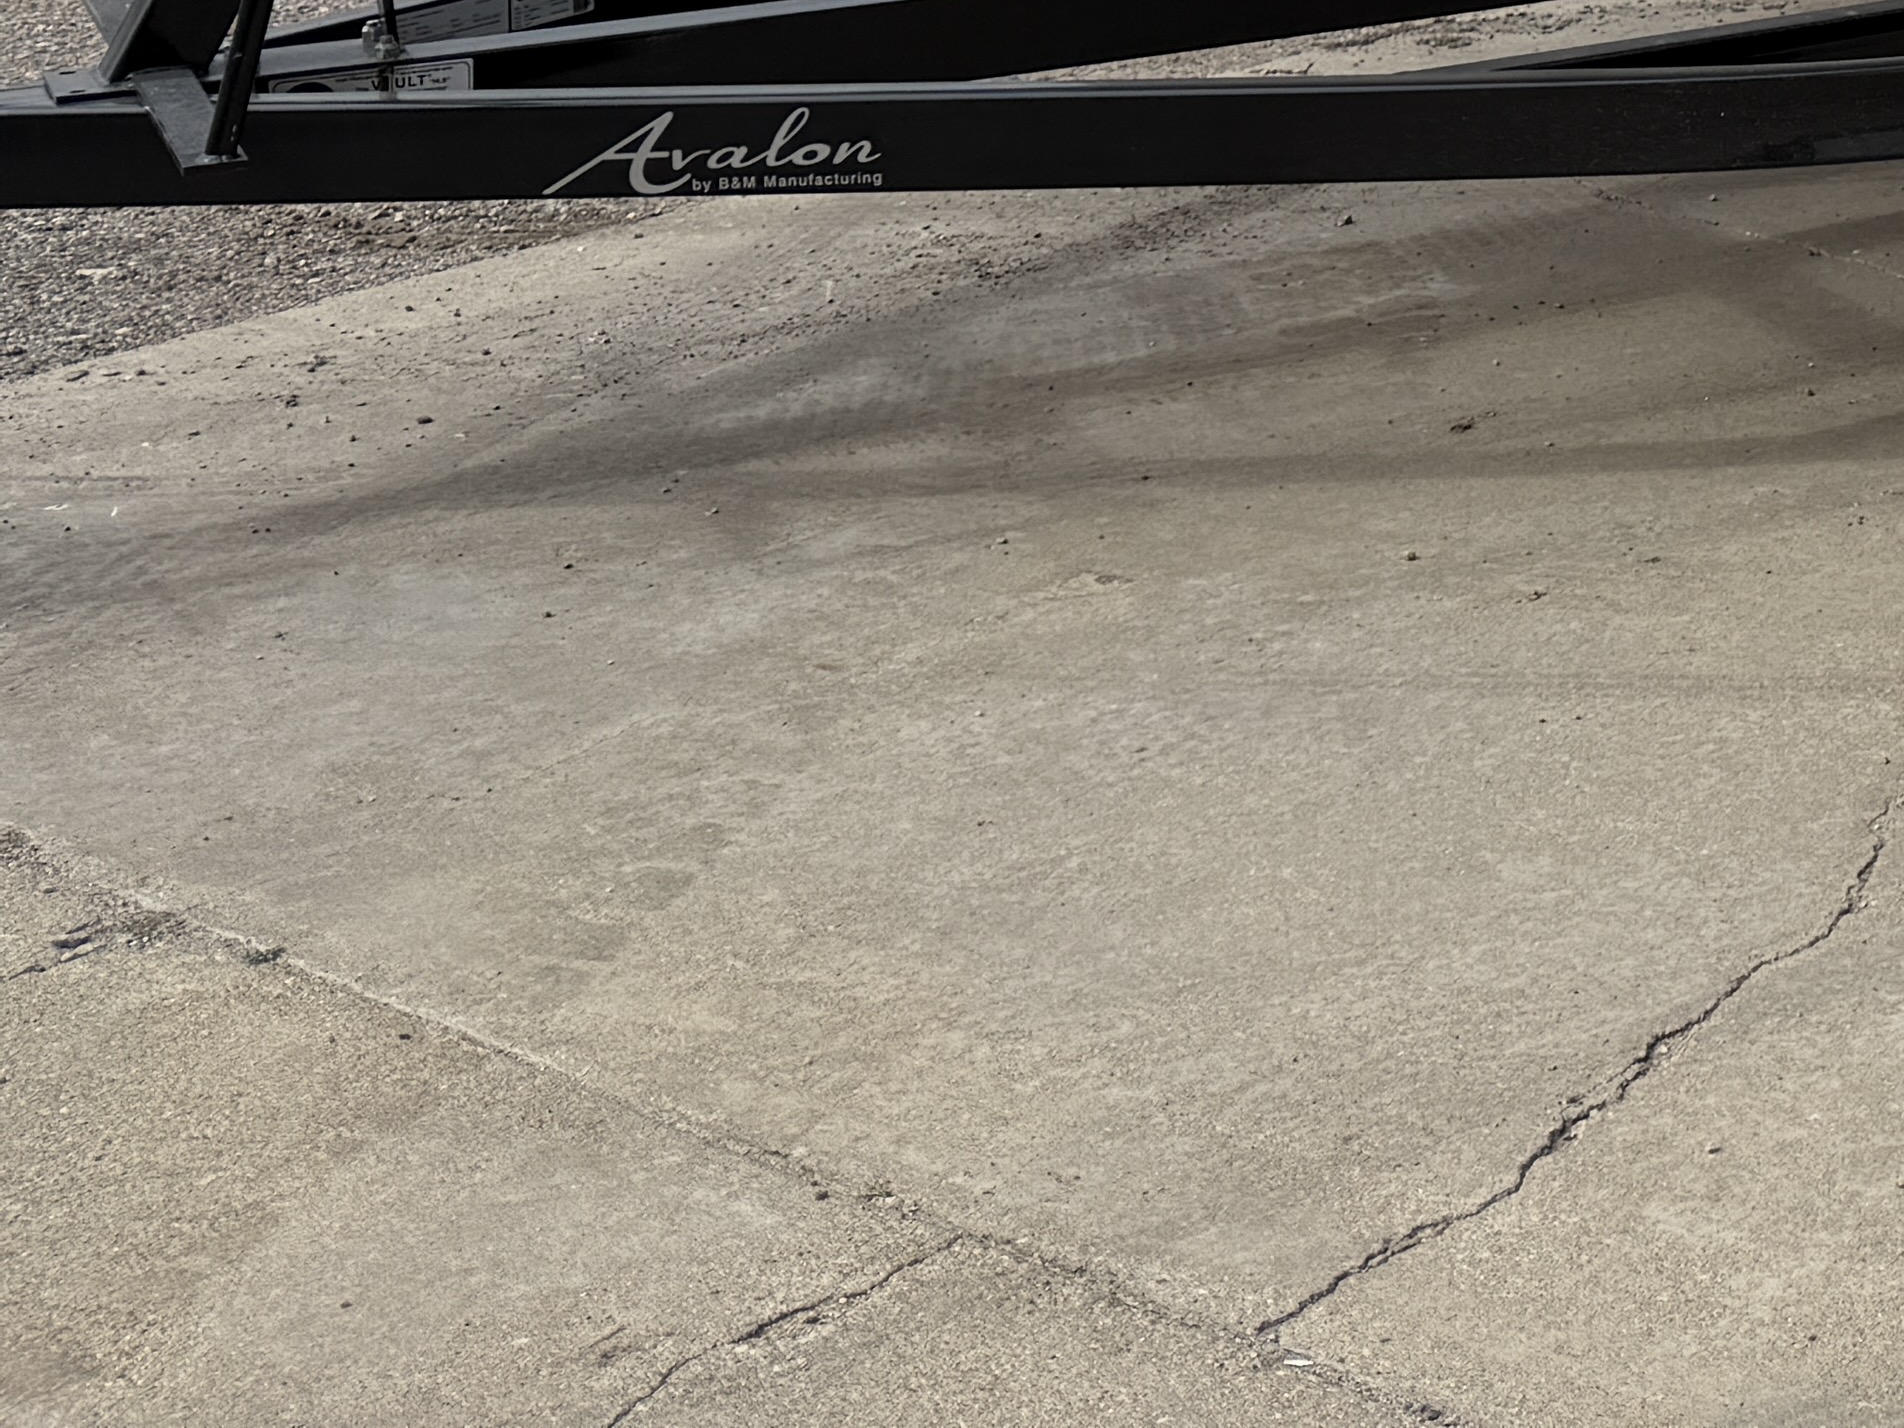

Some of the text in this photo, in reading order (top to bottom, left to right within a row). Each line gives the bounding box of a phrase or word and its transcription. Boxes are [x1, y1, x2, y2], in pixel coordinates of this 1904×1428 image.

[371, 74, 427, 91] VULT
[541, 106, 882, 195] Avalon
[691, 172, 883, 193] by B&M Manufacturing
